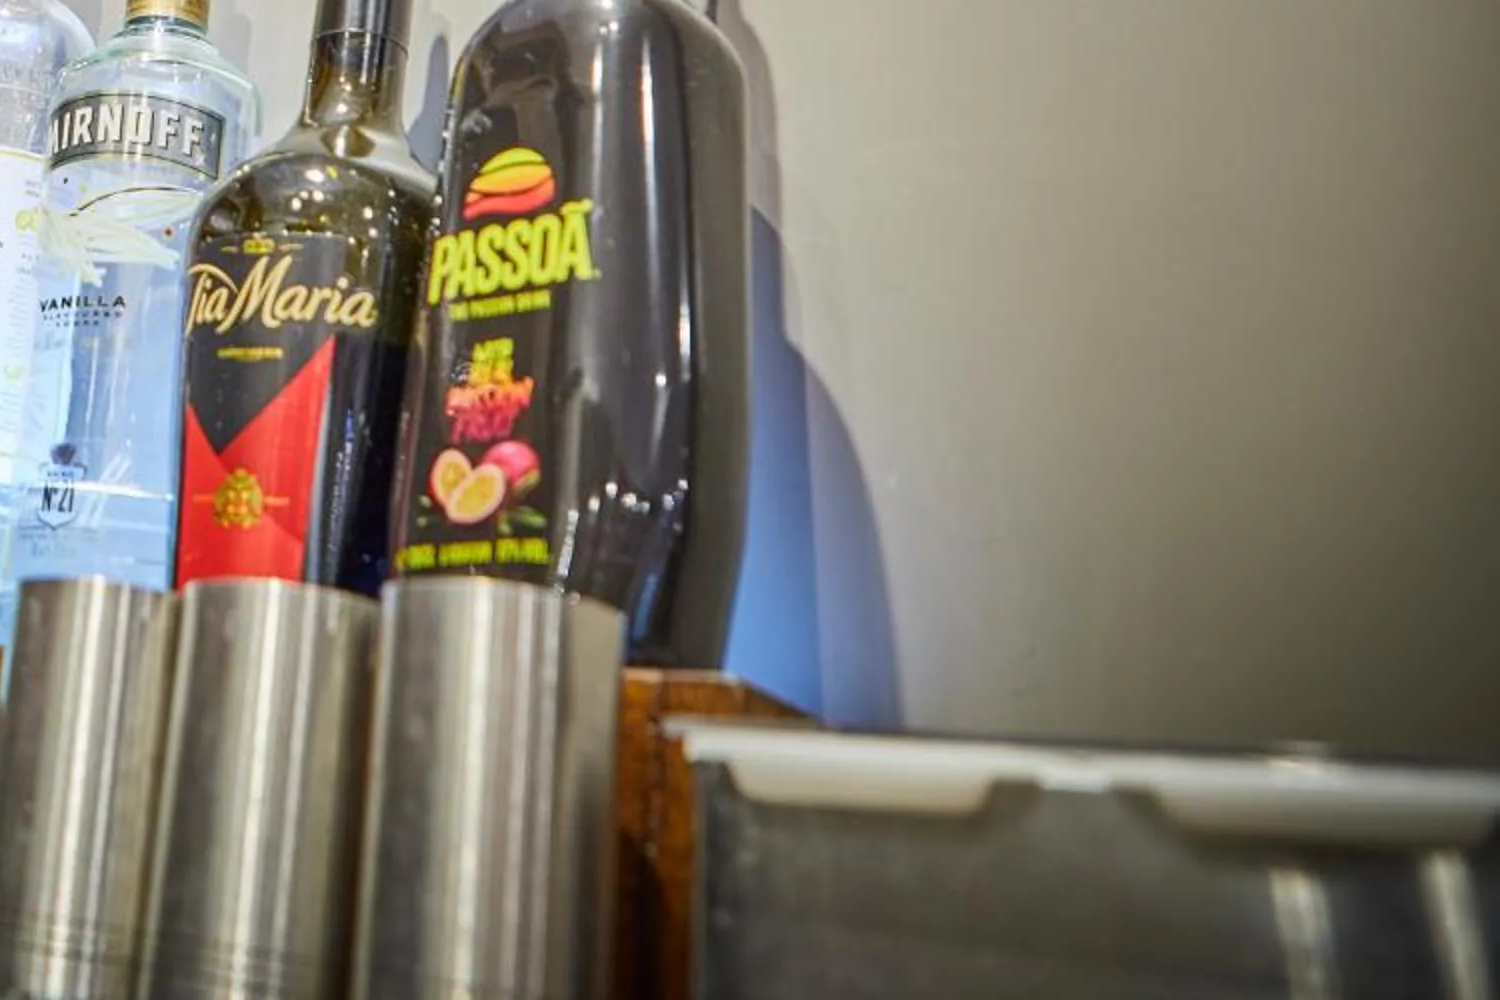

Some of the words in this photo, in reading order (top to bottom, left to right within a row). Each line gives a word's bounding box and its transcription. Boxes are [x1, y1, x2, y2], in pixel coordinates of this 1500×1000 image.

[39, 295, 127, 313] VANILLA
[185, 263, 238, 339] Tia
[215, 254, 378, 336] Maria
